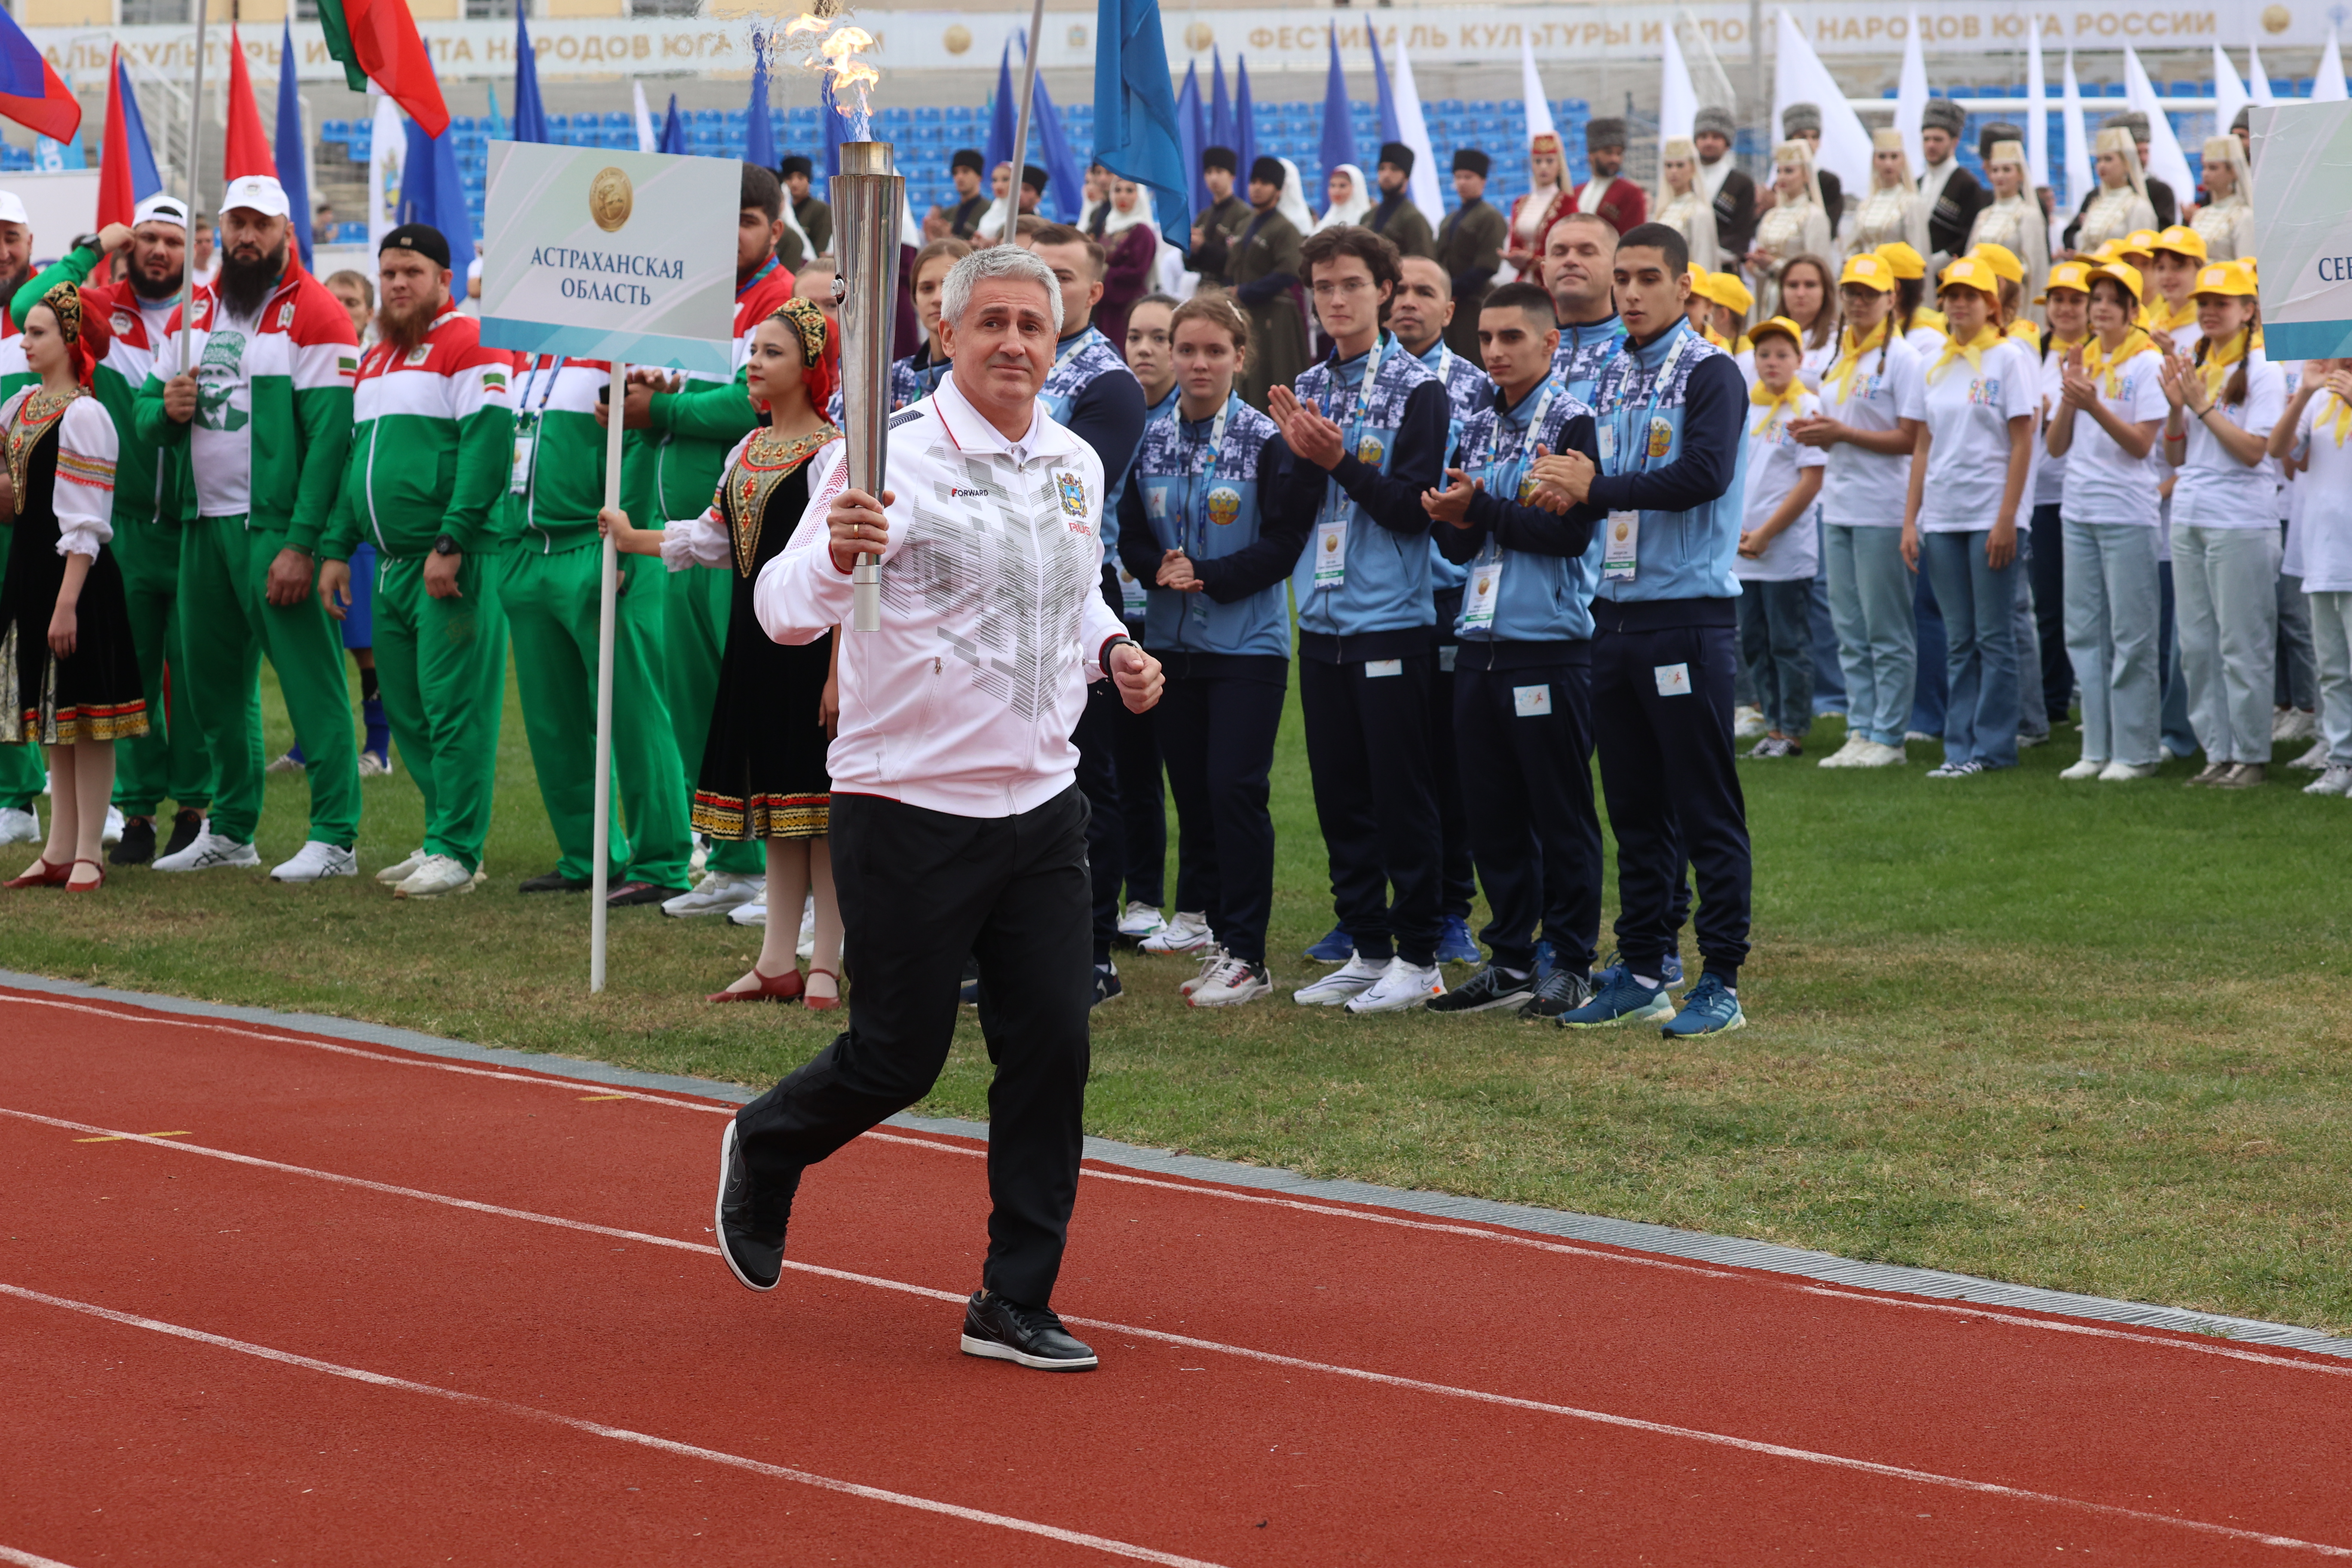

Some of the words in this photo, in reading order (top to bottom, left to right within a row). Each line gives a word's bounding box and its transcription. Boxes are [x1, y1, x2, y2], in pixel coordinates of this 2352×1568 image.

[1641, 20, 1663, 44] И
[2075, 12, 2217, 35] РОССИИ
[306, 40, 326, 63] И
[487, 35, 650, 63] НРОДОВ
[662, 32, 732, 59] ЮГА
[531, 246, 683, 279] АСТРАХАНСКАЯ
[561, 278, 651, 305] ОБЛАСТЬ
[952, 488, 989, 497] FORWARD
[1069, 522, 1091, 536] RUS
